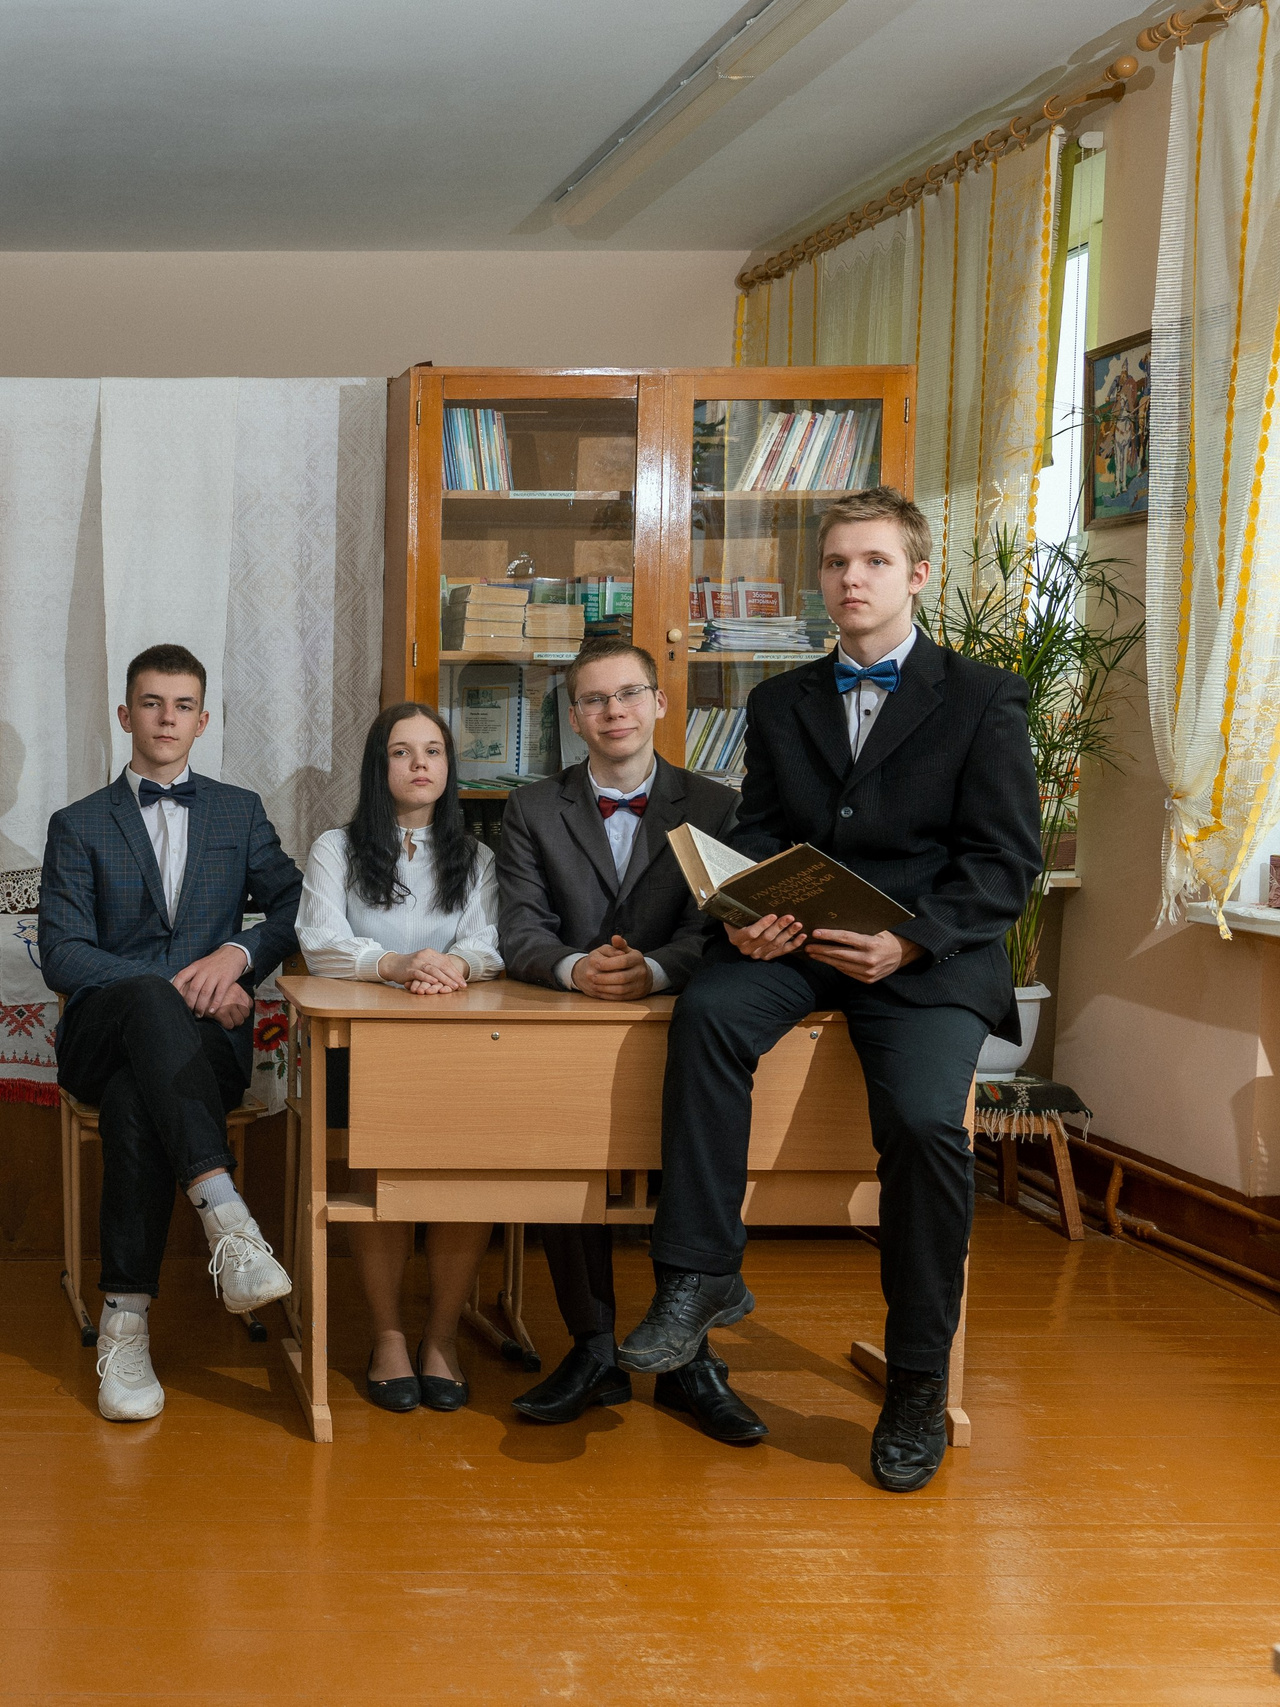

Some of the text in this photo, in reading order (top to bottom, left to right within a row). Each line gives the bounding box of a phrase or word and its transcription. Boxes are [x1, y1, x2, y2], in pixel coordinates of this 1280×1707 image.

[749, 862, 826, 900] ТЛУМАЧАЛЬНЫ
[769, 874, 835, 907] БЕЛАРУСКАЙ
[791, 887, 824, 905] МОВЫ
[827, 911, 838, 919] 3
